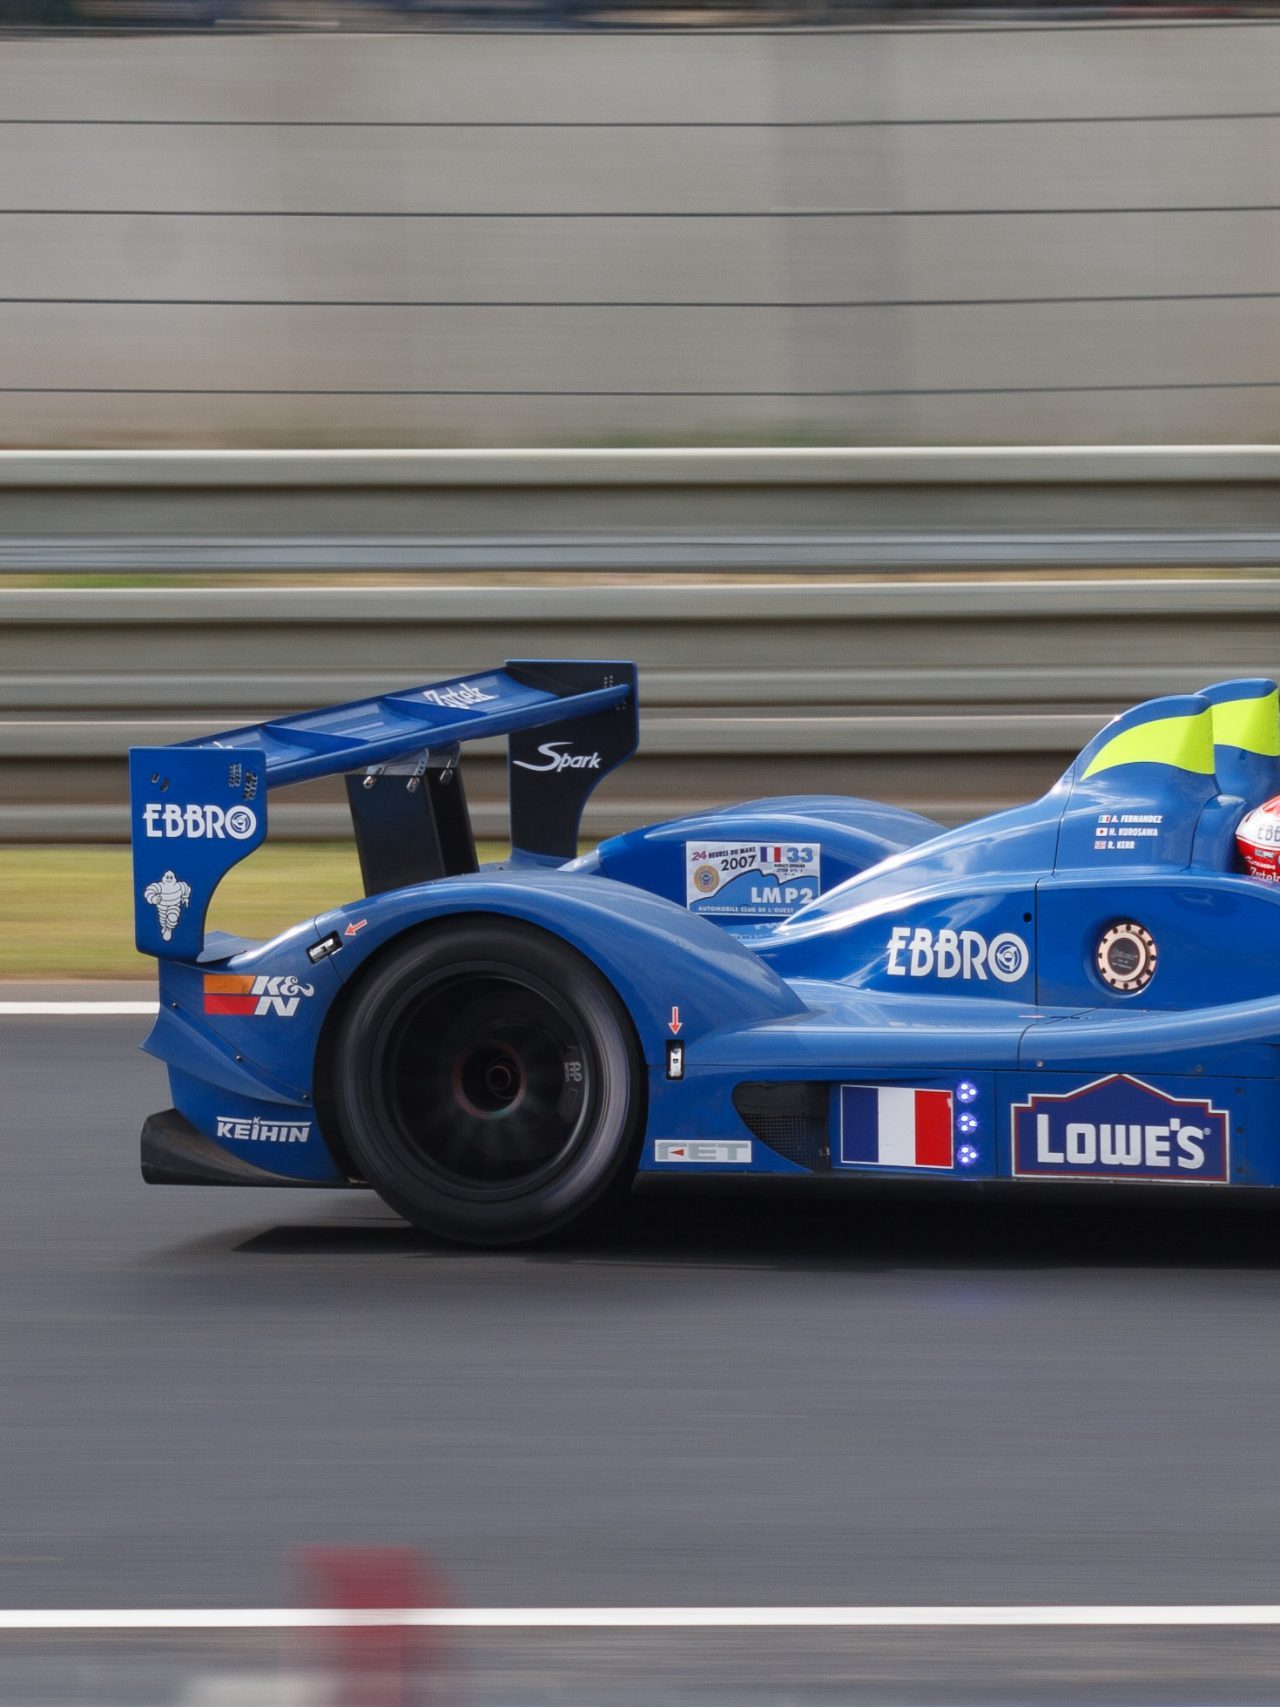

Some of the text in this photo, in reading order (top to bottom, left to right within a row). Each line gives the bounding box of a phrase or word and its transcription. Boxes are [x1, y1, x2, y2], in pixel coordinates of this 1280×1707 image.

[512, 741, 602, 772] Spark
[143, 803, 257, 840] EBBRO
[691, 851, 707, 861] 24
[720, 855, 757, 871] 2007
[786, 847, 814, 863] 33
[886, 926, 1029, 983] EBBRO
[215, 1118, 312, 1143] KEIHIN
[1036, 1114, 1205, 1170] LOWE'S
